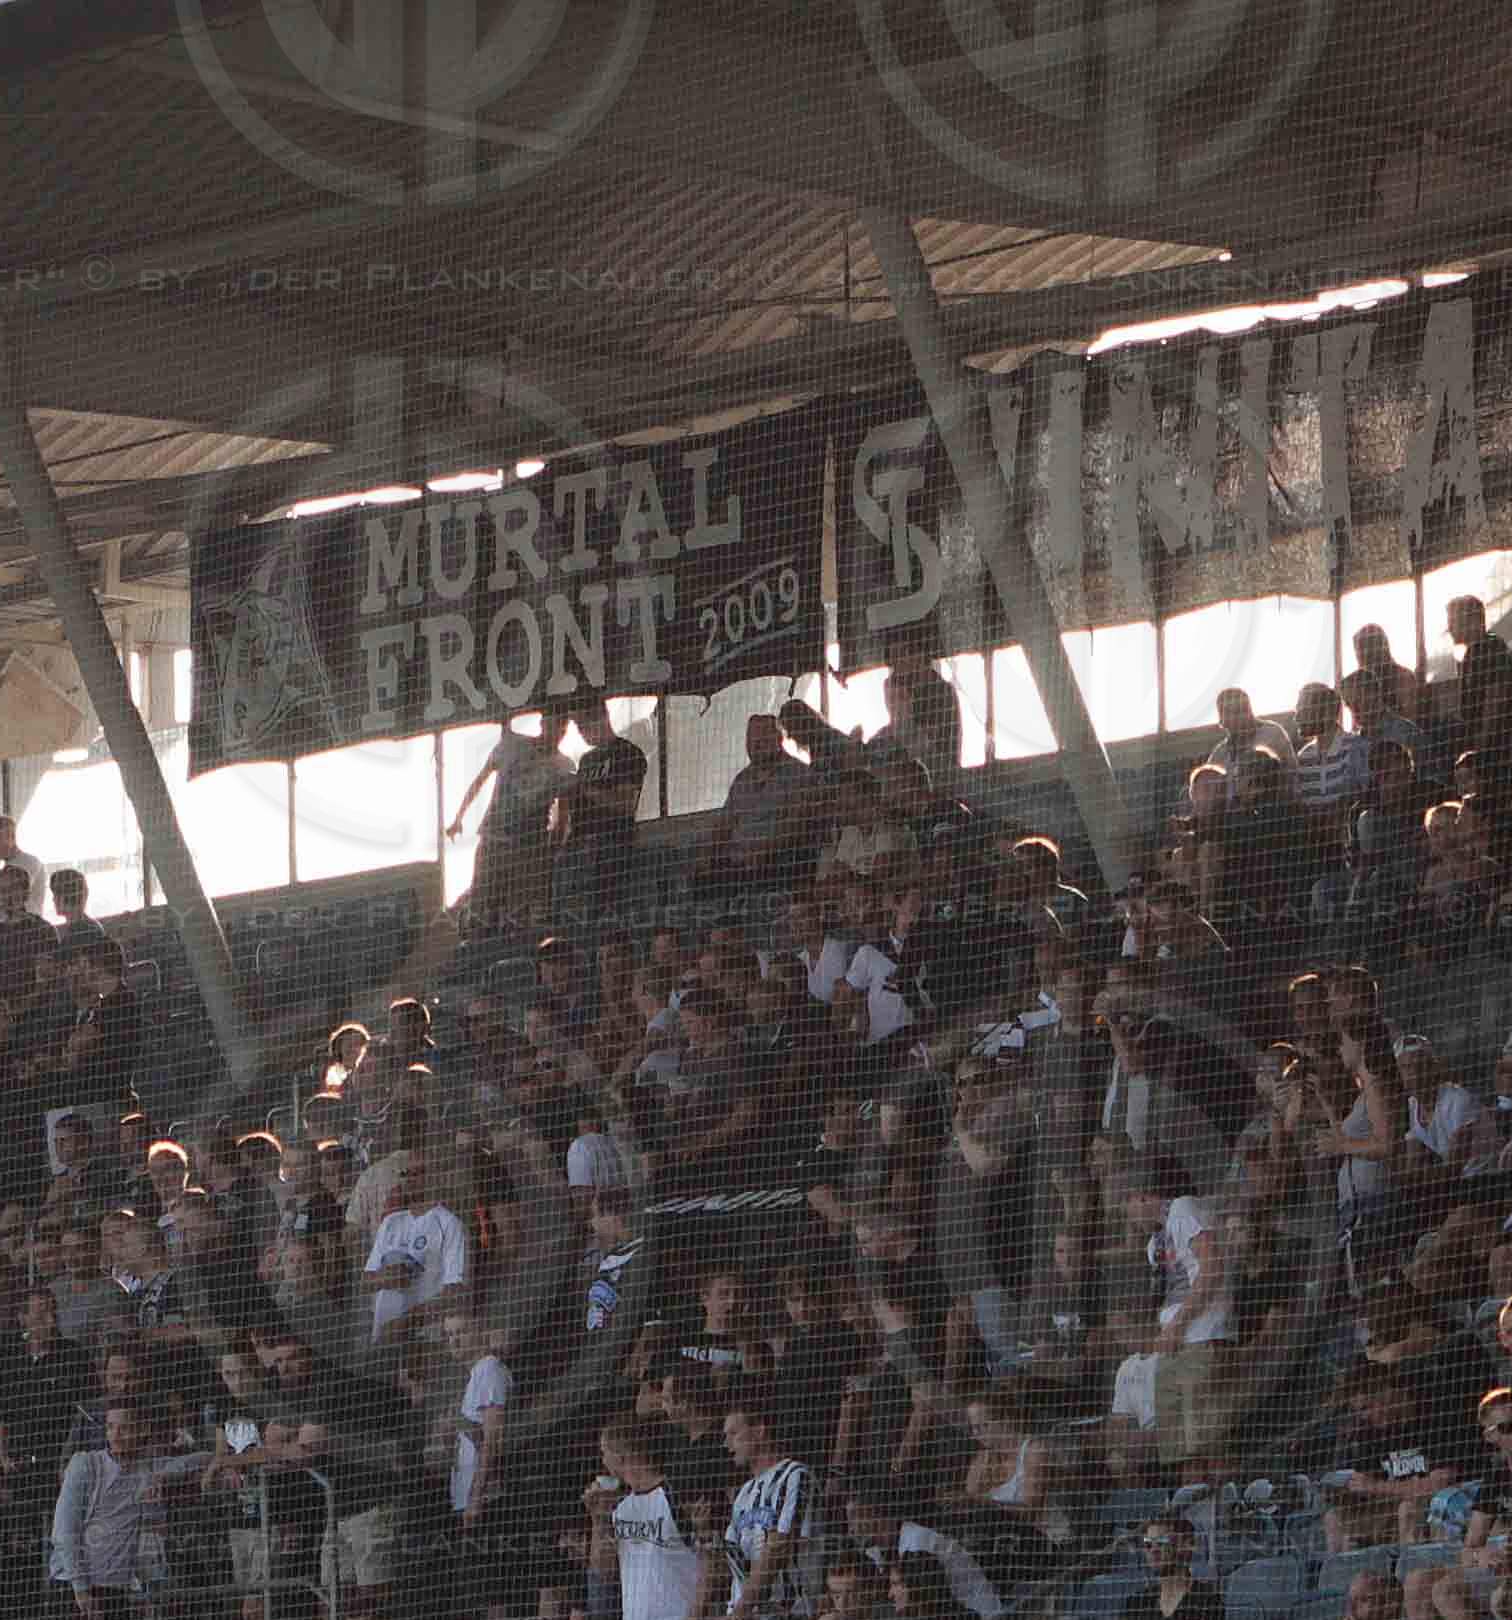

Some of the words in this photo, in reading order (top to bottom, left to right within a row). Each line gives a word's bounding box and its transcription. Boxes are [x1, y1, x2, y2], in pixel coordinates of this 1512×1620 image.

[360, 446, 742, 614] MURTAL
[359, 573, 678, 732] FRONT
[697, 567, 800, 660] 2009
